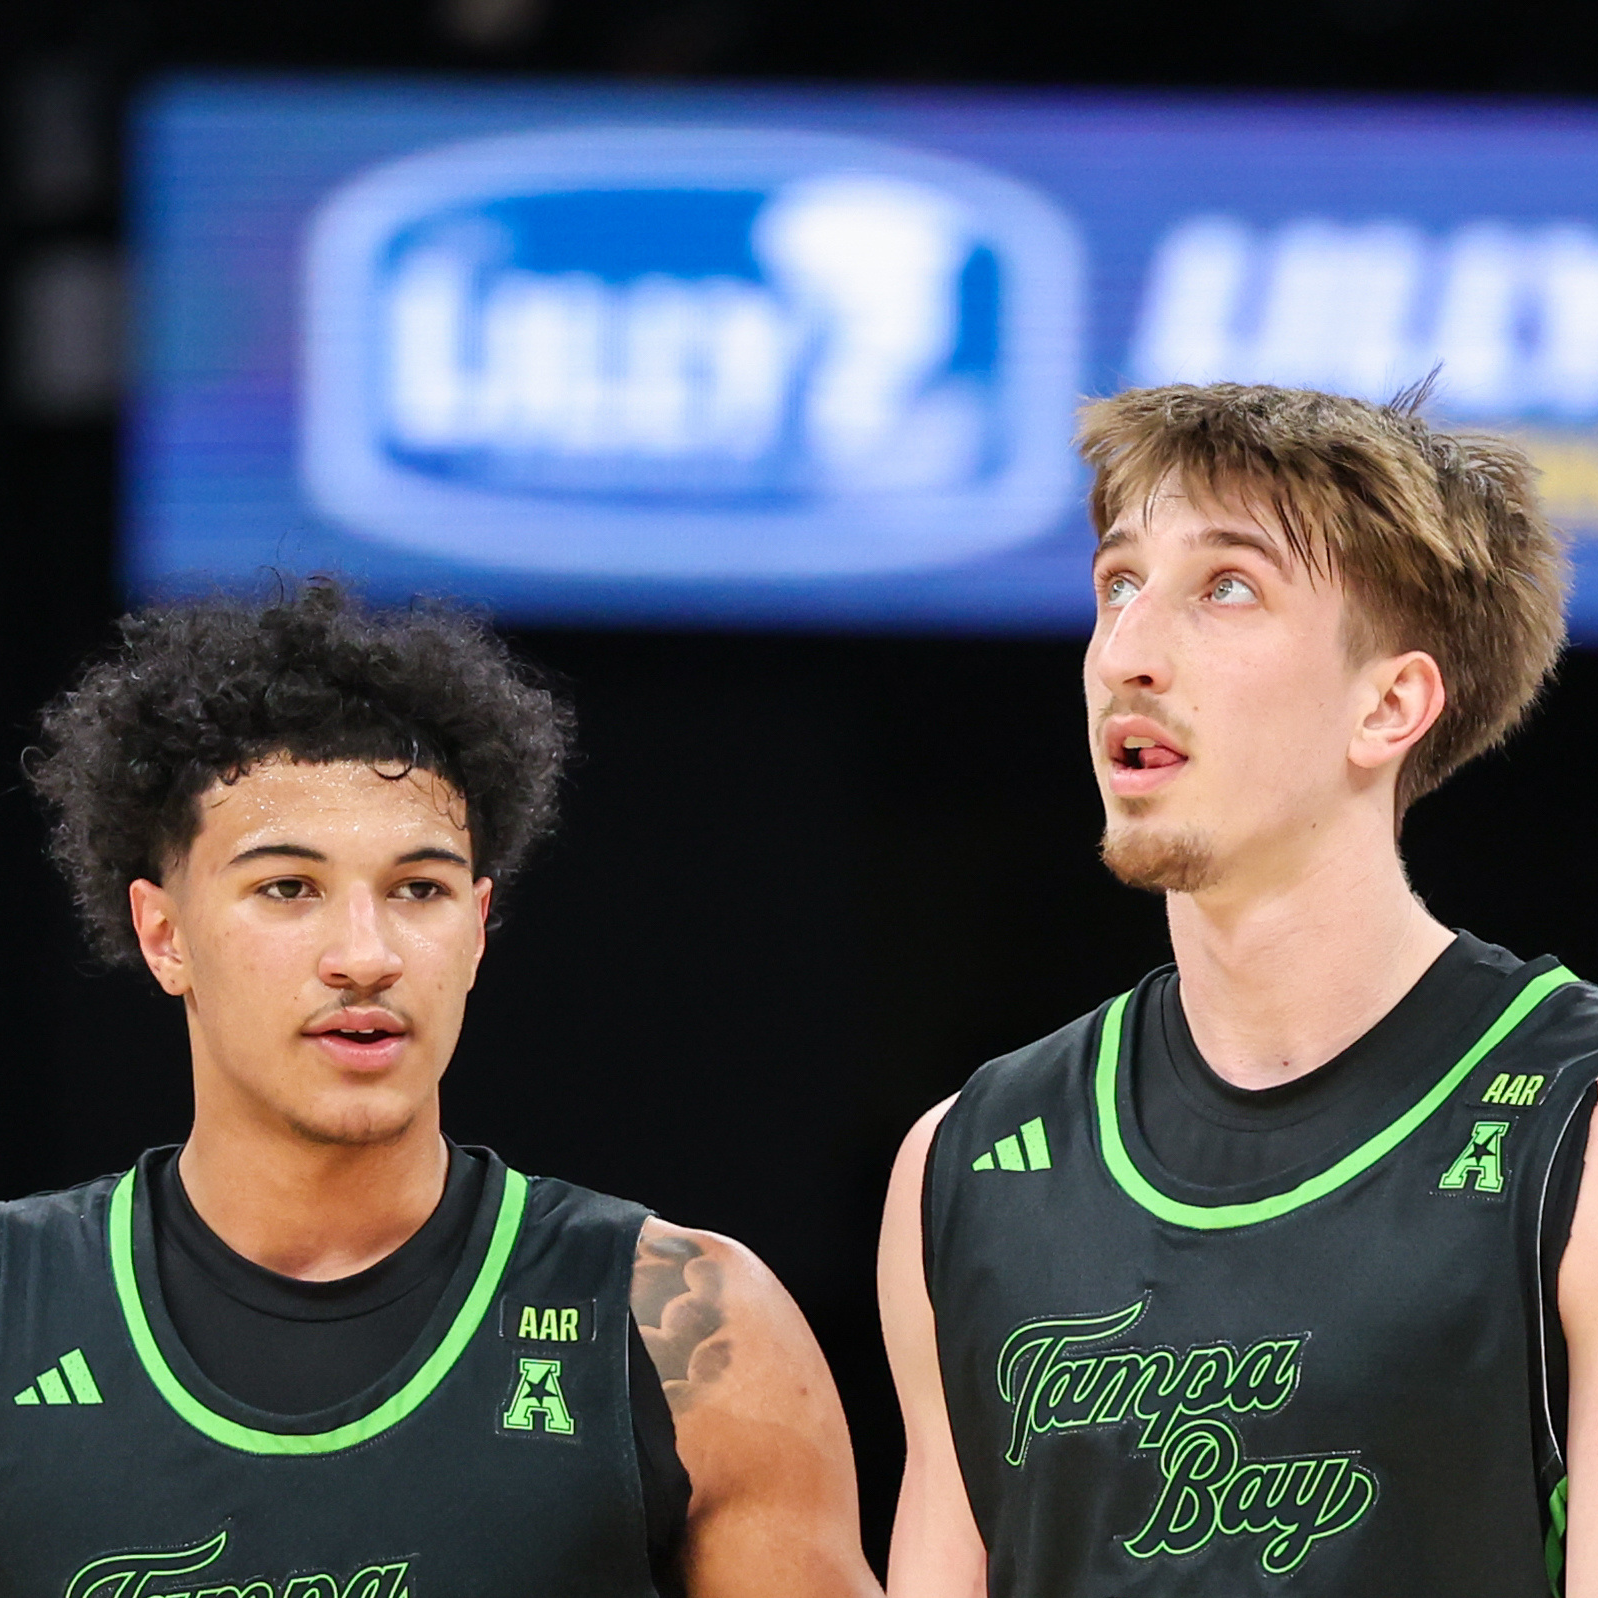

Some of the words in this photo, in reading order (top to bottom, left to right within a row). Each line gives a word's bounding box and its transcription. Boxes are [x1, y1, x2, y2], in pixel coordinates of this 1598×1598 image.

[1480, 1072, 1545, 1107] AAR
[517, 1305, 579, 1342] AAR
[997, 1298, 1301, 1468] Tampa
[1122, 1417, 1375, 1575] Bay
